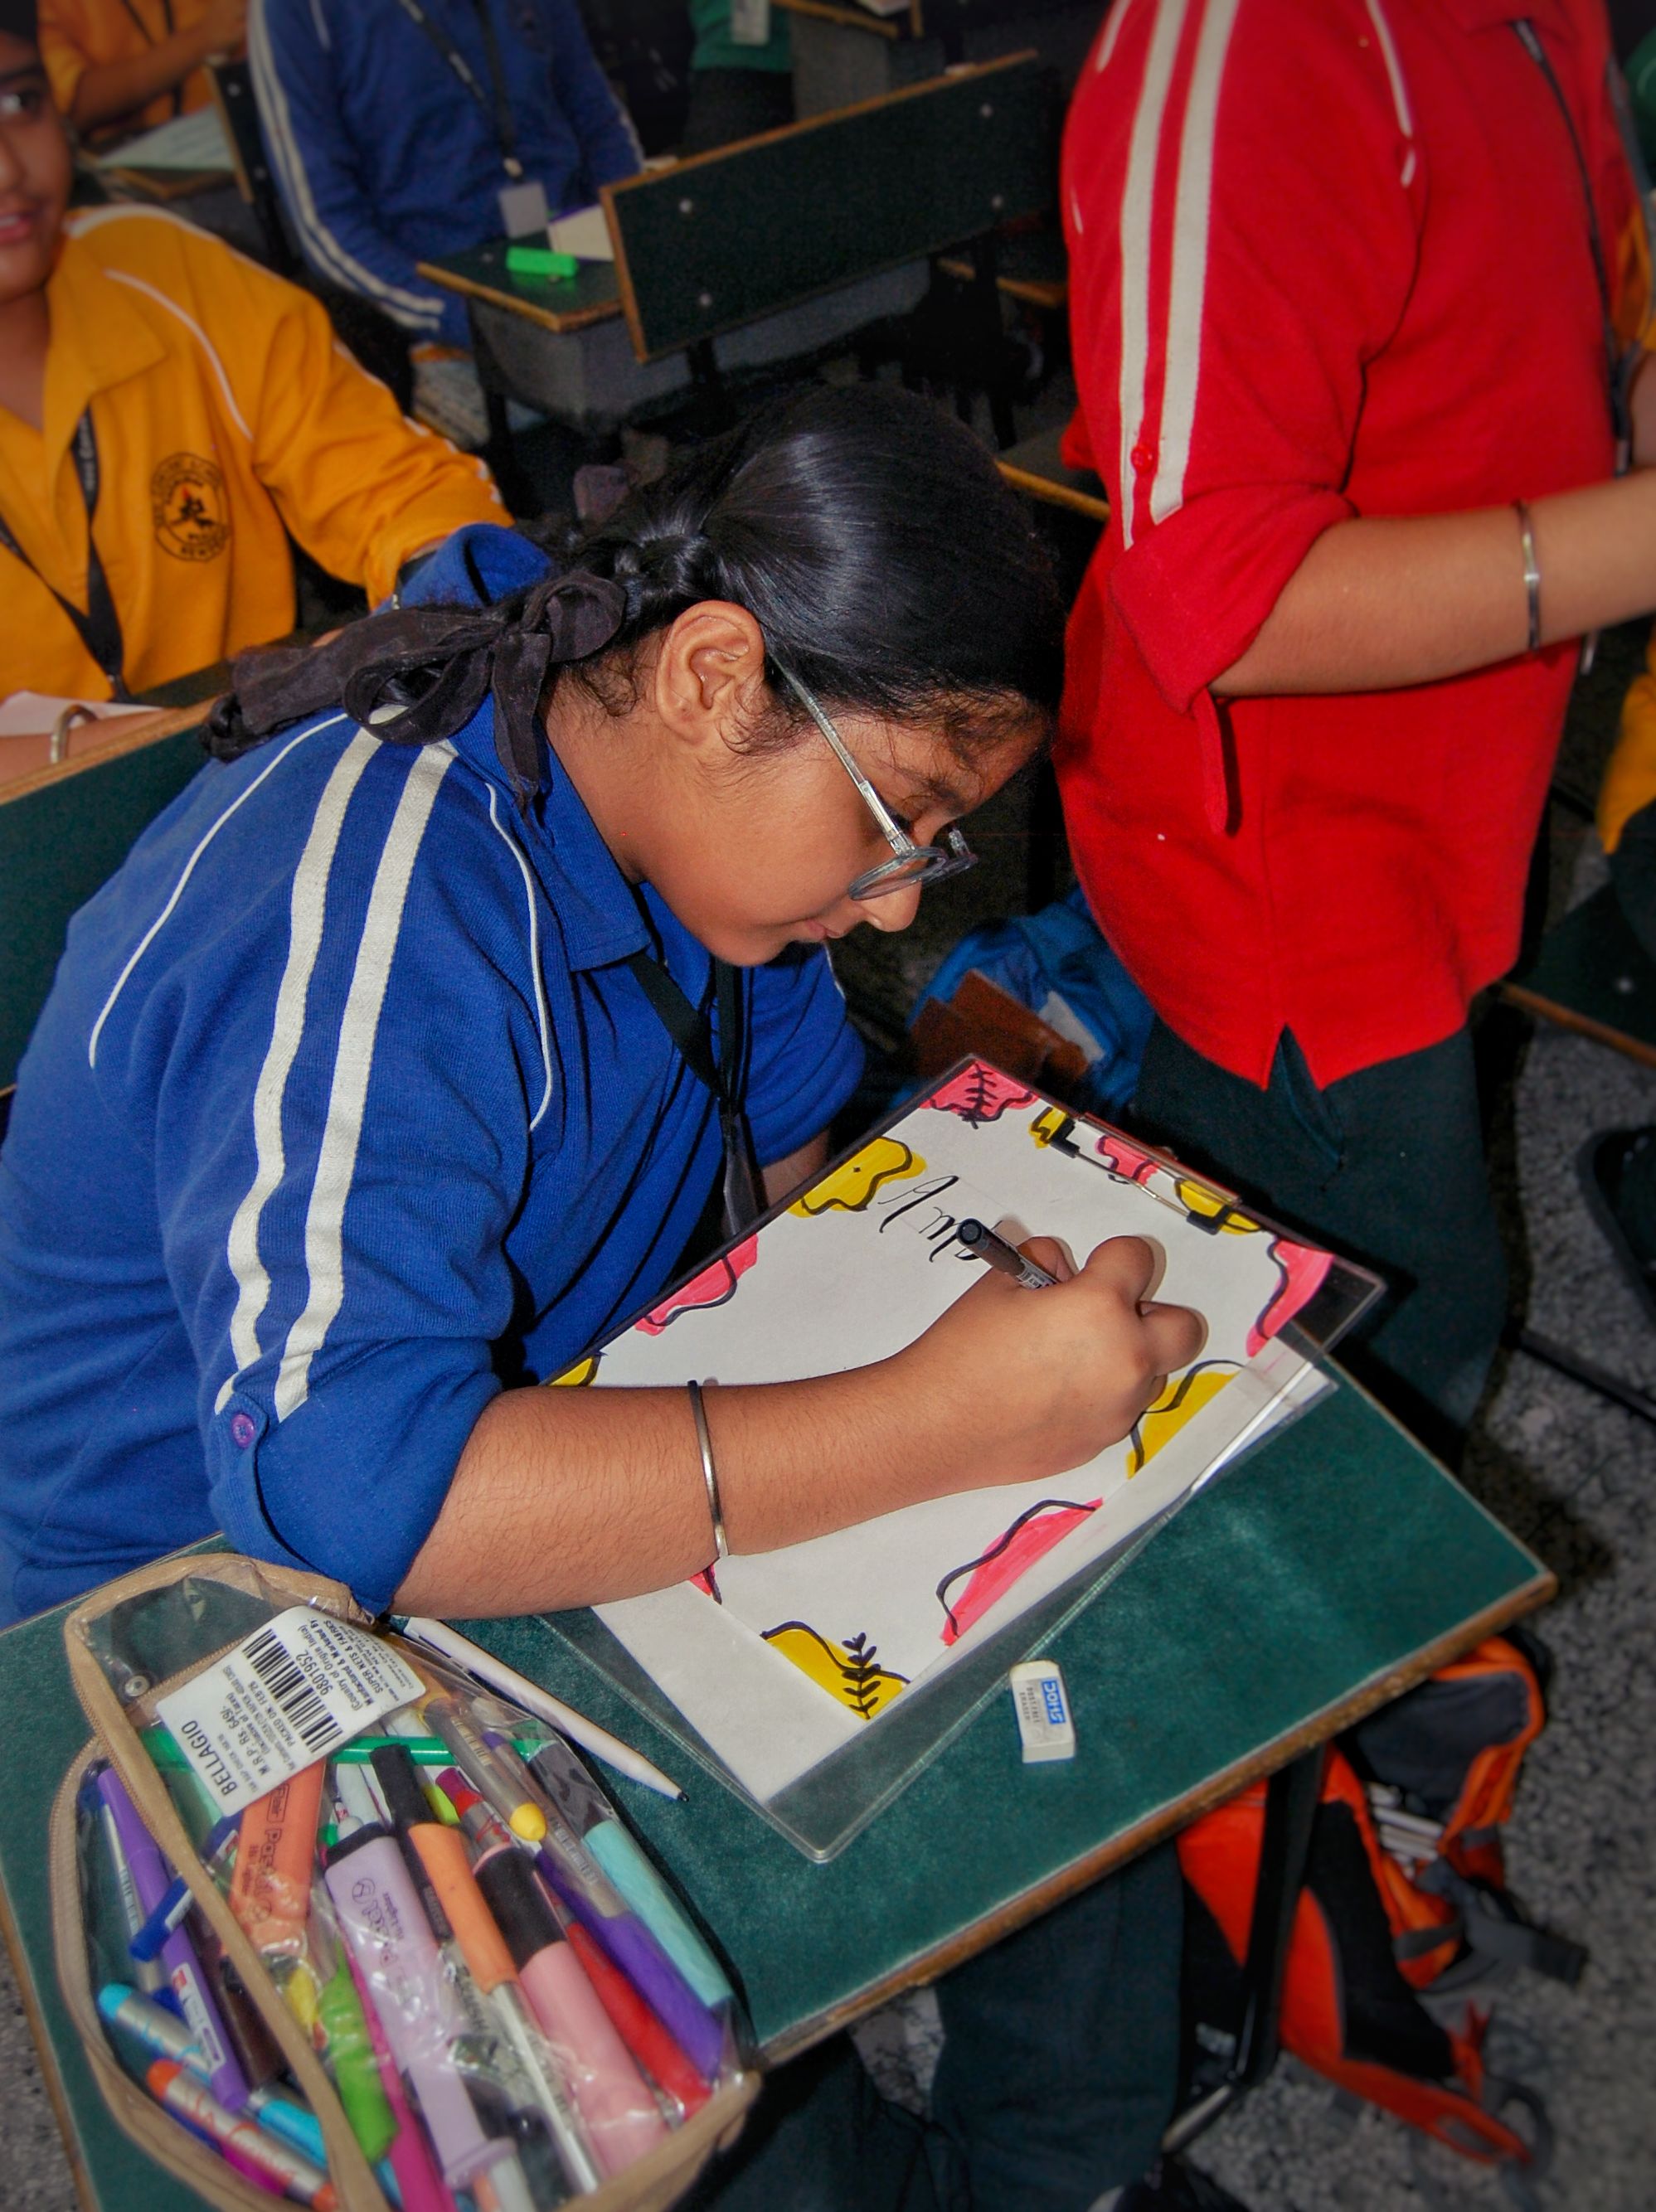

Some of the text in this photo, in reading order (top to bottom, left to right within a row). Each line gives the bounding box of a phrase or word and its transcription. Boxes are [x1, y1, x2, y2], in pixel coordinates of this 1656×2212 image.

[343, 1644, 352, 1652] &
[294, 1648, 333, 1696] 9801952
[296, 1623, 363, 1711] (Country of Origin India)
[348, 1652, 366, 1671] NETS
[362, 1668, 383, 1694] SUPER
[217, 1703, 240, 1729] 649/-
[233, 1726, 250, 1745] Rs.
[272, 1717, 296, 1748] PACKED
[179, 1718, 238, 1796] BELLAGIO
